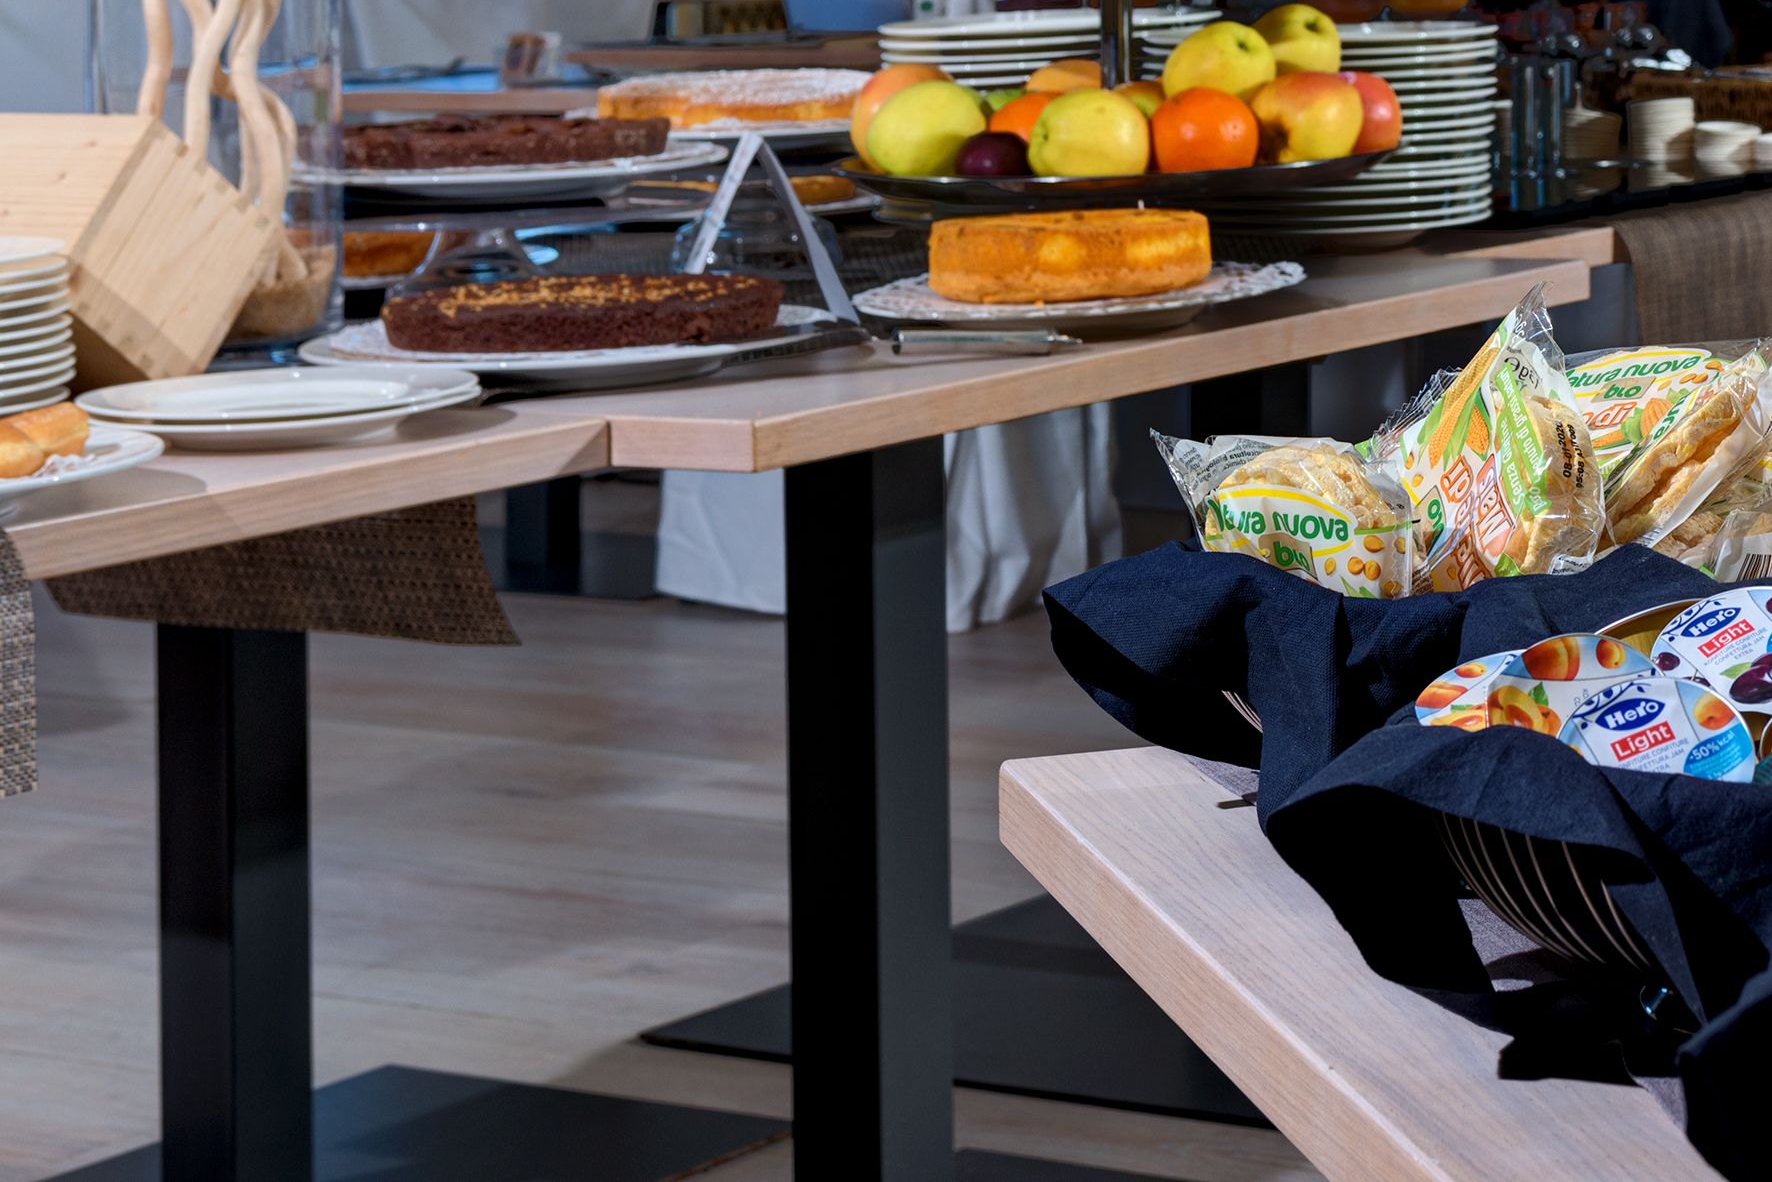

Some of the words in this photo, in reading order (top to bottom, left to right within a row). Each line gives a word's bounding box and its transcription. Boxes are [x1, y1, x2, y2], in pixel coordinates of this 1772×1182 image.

[1499, 366, 1516, 398] saturi
[1621, 355, 1701, 379] nuova
[1603, 383, 1642, 399] bio
[1507, 394, 1528, 428] grassi
[1504, 463, 1525, 506] Senza
[1479, 467, 1512, 546] Mais
[1274, 511, 1348, 541] nuova
[1689, 608, 1736, 637] Hero
[1701, 622, 1751, 655] Light
[1604, 700, 1659, 729] Hero
[1615, 724, 1671, 757] Light
[1689, 742, 1720, 760] -50%
